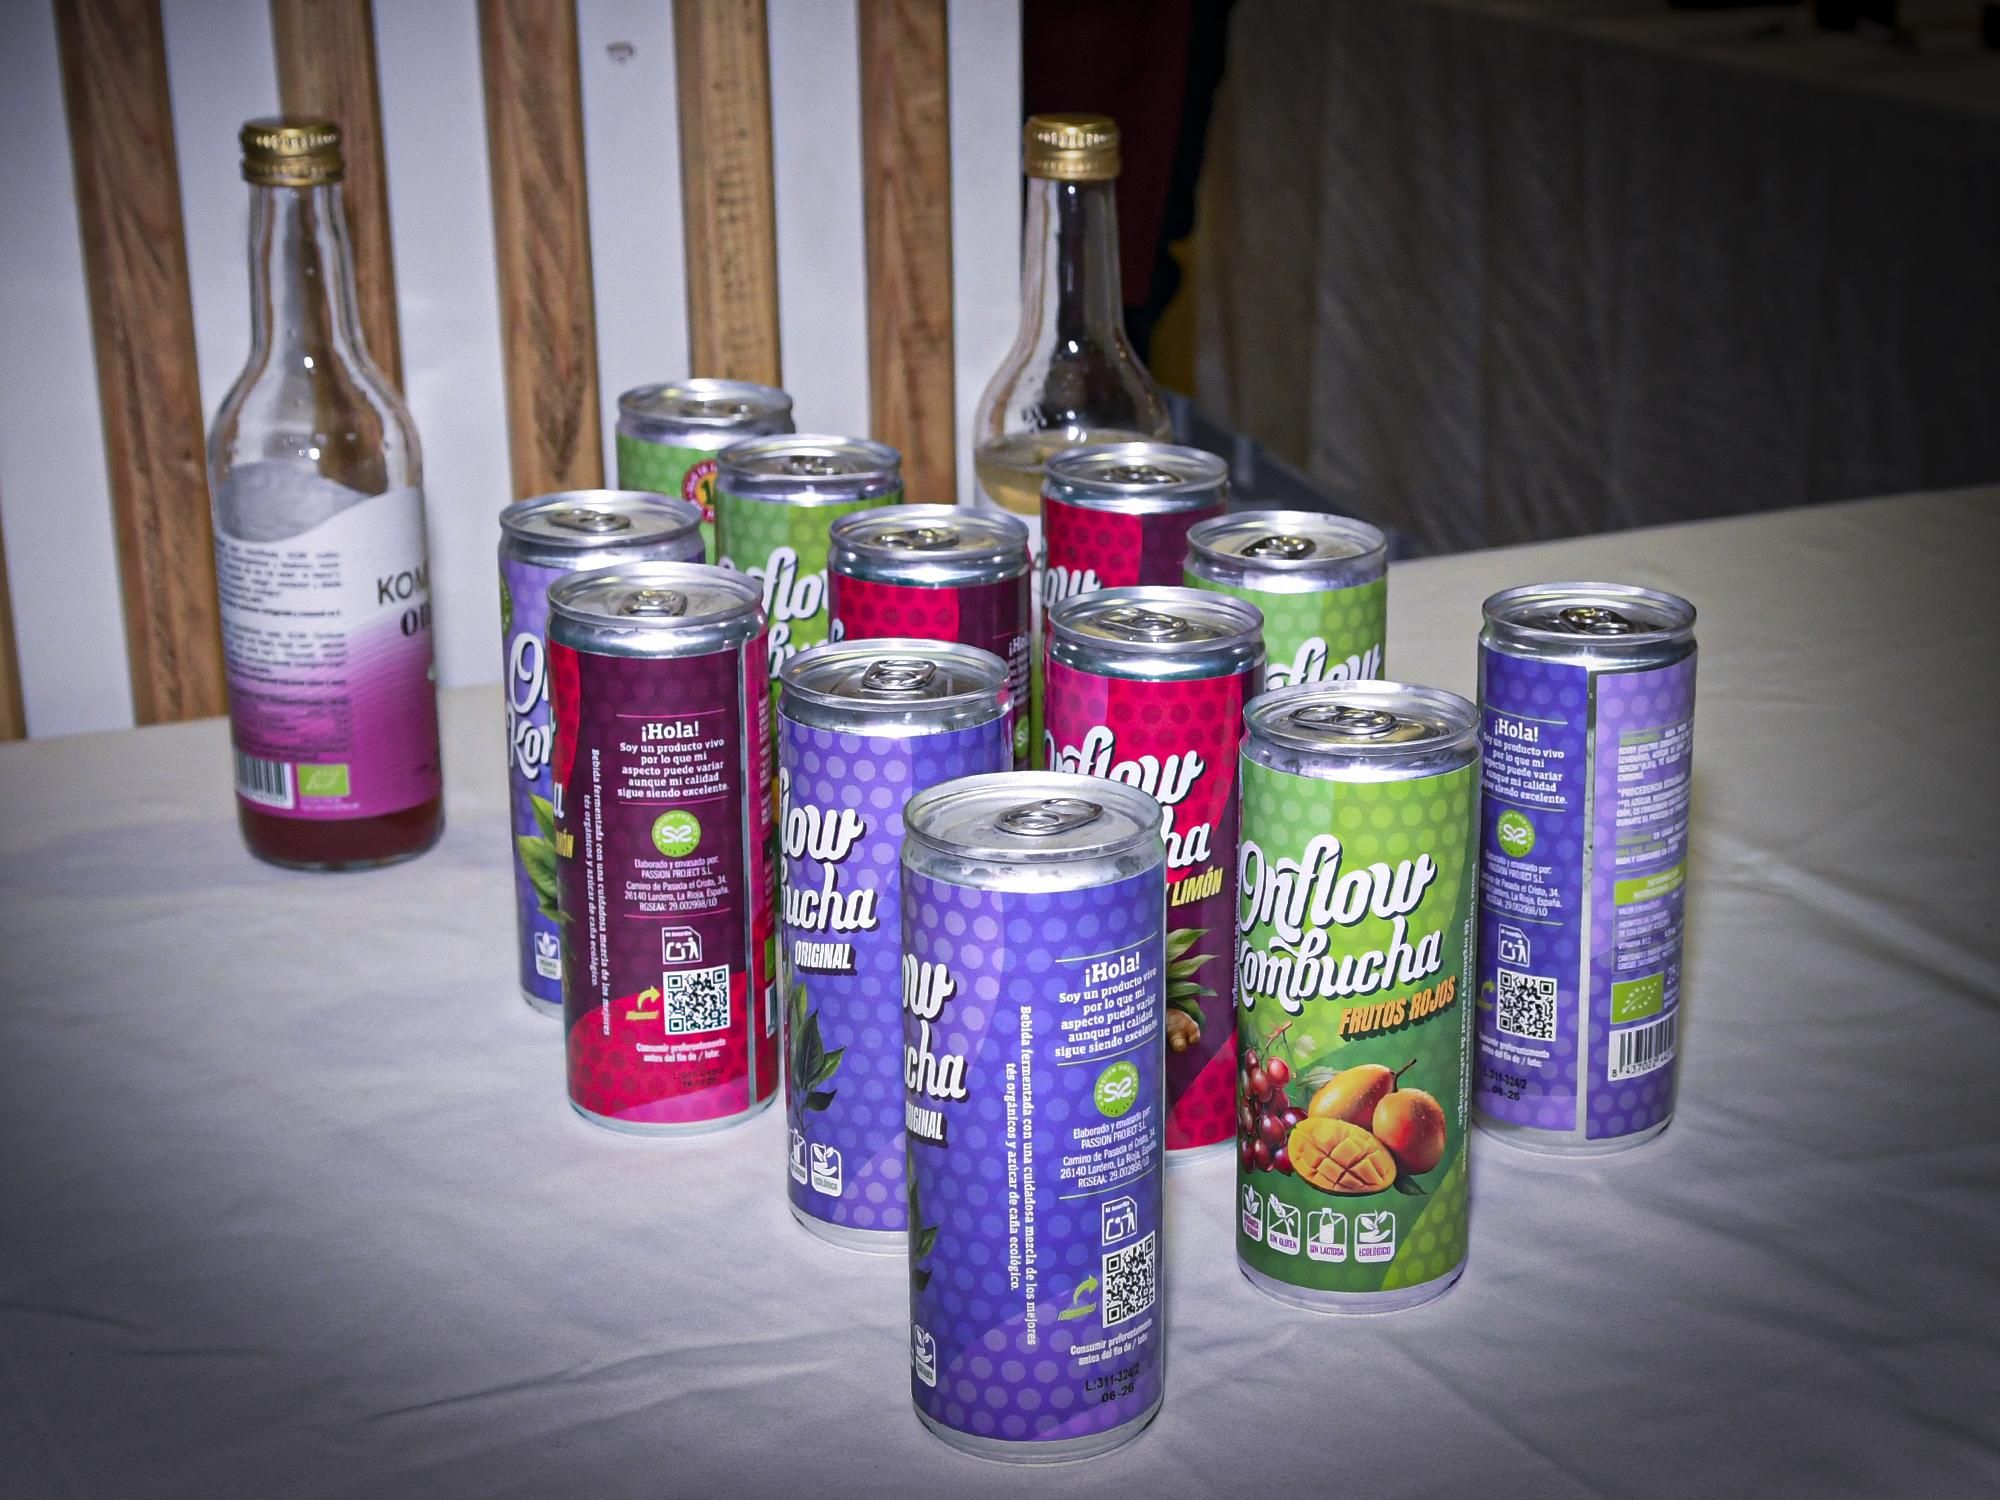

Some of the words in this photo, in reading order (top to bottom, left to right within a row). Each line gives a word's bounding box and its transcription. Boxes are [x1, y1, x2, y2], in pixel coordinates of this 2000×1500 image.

[641, 721, 699, 742] ¡Hola!
[1495, 718, 1538, 742] ¡Hola!
[620, 742, 638, 754] Soy
[657, 742, 702, 754] producto
[705, 739, 724, 749] vivo
[1504, 742, 1541, 756] producto
[1543, 749, 1564, 758] vivo
[592, 748, 600, 782] Bebida
[641, 756, 658, 765] por
[661, 754, 670, 764] lo
[673, 755, 692, 765] que
[694, 751, 707, 761] mi
[1493, 750, 1504, 759] por
[1505, 752, 1513, 762] lo
[1515, 756, 1529, 766] que
[1532, 759, 1544, 768] mi
[622, 767, 660, 777] aspecto
[664, 765, 694, 777] puede
[696, 761, 724, 772] variar
[1507, 765, 1531, 777] puede
[1533, 771, 1562, 781] variar
[629, 778, 666, 787] aunque
[669, 777, 682, 786] mi
[685, 772, 719, 785] calidad
[1510, 778, 1521, 786] mi
[1523, 781, 1556, 792] calidad
[617, 788, 644, 799] sigue
[646, 788, 680, 798] siendo
[683, 783, 730, 797] excelente.
[1520, 791, 1568, 804] excelente.
[594, 784, 604, 841] fermentada
[584, 811, 593, 859] orgánicos
[634, 859, 668, 868] Elaborado
[641, 870, 671, 879] PASSION
[672, 869, 700, 878] PROJECT
[624, 891, 646, 900] 26140
[677, 891, 685, 900] La
[626, 881, 651, 891] Camino
[653, 882, 661, 890] de
[663, 881, 687, 891] Pasada
[689, 880, 695, 888] el
[1171, 865, 1223, 907] LIMÓN
[588, 902, 596, 915] de
[598, 884, 607, 932] cuidadosa
[600, 933, 608, 968] mezcla
[795, 940, 852, 970] ORIGINAL
[601, 968, 610, 981] de
[1085, 952, 1140, 987] ¡Hola!
[602, 981, 610, 996] los
[1059, 993, 1081, 1004] Soy
[1084, 990, 1098, 999] un
[1101, 976, 1142, 998] producto
[1143, 967, 1157, 982] vivo
[1083, 1003, 1102, 1016] por
[1105, 999, 1114, 1009] lo
[1117, 994, 1133, 1007] que
[1135, 986, 1145, 999] mi
[1339, 999, 1407, 1034] FRUTOS
[1408, 975, 1456, 1022] ROJOS
[1061, 1015, 1104, 1031] aspecto
[1107, 1005, 1135, 1024] puede
[1136, 994, 1156, 1010] variar
[1021, 1006, 1033, 1046] Bebida
[1068, 1027, 1110, 1042] aunque
[1112, 1021, 1125, 1034] mi
[1127, 1008, 1153, 1028] calidad
[1055, 1045, 1086, 1058] sigue
[1088, 1036, 1123, 1052] siendo
[1006, 1063, 1016, 1081] tés
[1022, 1049, 1034, 1116] fermentada
[1004, 1083, 1018, 1139] orgánicos
[1023, 1119, 1032, 1139] con
[1073, 1123, 1110, 1139] Elaborado
[1081, 1135, 1112, 1150] PASSION
[1113, 1124, 1138, 1141] PROJECT
[1005, 1140, 1016, 1149] y
[1023, 1142, 1032, 1164] una
[1063, 1154, 1092, 1166] Camino
[1094, 1152, 1102, 1161] de
[1128, 1142, 1134, 1151] el
[1008, 1150, 1019, 1189] azúcar
[1060, 1168, 1086, 1179] 26140
[1088, 1162, 1116, 1175] Lardero,
[1117, 1156, 1124, 1165] La
[1078, 1176, 1108, 1188] RGSEAA:
[1009, 1192, 1020, 1205] de
[1024, 1166, 1036, 1223] cuidadosa
[1009, 1208, 1020, 1234] caña
[1025, 1226, 1037, 1265] mezcla
[1279, 1235, 1297, 1249] GLUTEN
[1310, 1245, 1319, 1253] SIN
[1320, 1245, 1344, 1256] LACTOSA
[1359, 1246, 1391, 1256] ECOLÓGICO
[1008, 1237, 1022, 1291] ecológico.
[1026, 1267, 1037, 1281] de
[1026, 1283, 1037, 1300] los
[1025, 1302, 1038, 1346] mejores
[1070, 1340, 1106, 1355] Consumir
[1101, 1349, 1112, 1359] del
[1124, 1343, 1131, 1352] de
[1102, 1382, 1134, 1403] 06-26
